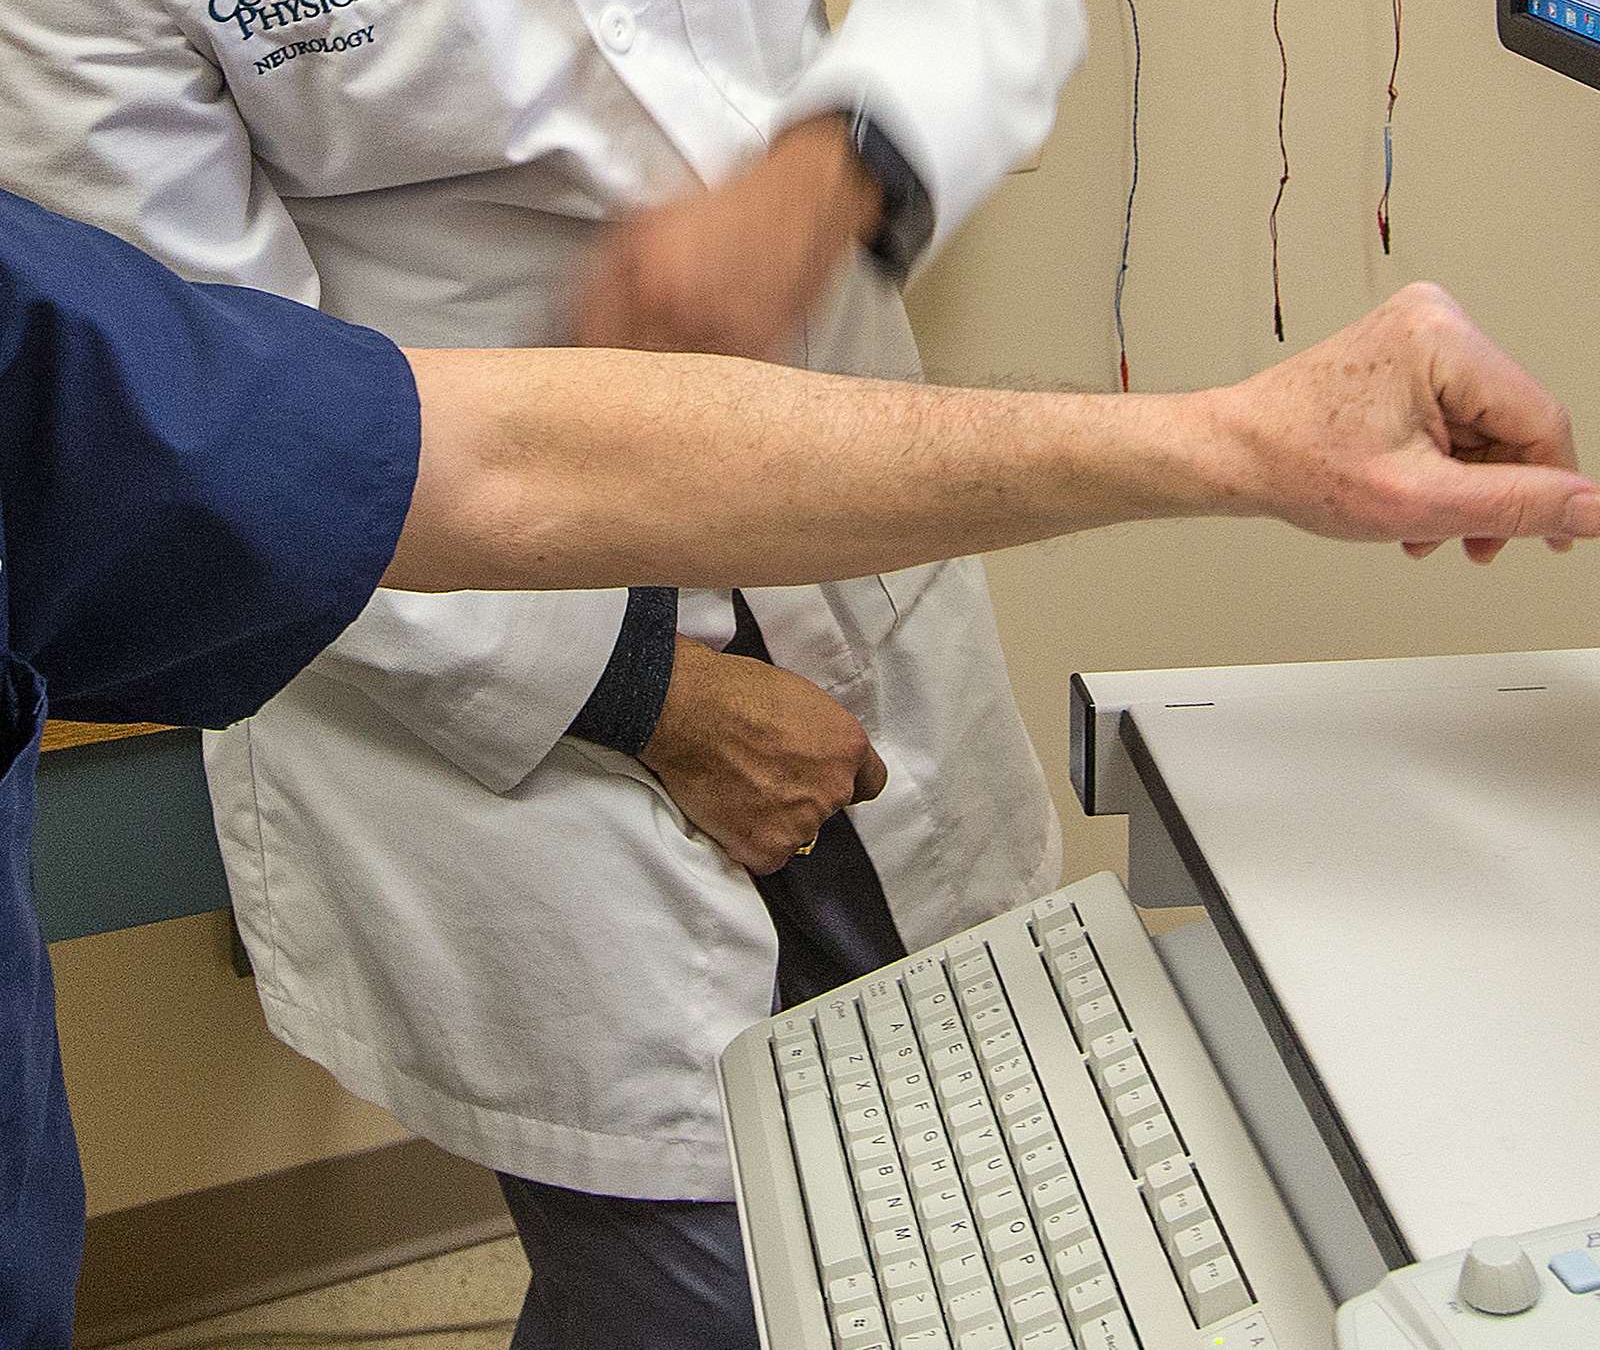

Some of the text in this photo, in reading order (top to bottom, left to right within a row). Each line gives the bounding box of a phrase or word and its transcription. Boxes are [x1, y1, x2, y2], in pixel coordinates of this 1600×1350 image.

[253, 25, 376, 76] NEUROLOGY
[932, 993, 947, 1004] Q
[890, 1022, 905, 1032] A
[941, 1018, 957, 1031] W
[899, 1047, 913, 1057] S
[949, 1042, 964, 1054] E
[849, 1054, 864, 1064] Z
[906, 1074, 920, 1085] D
[958, 1070, 973, 1082] R
[856, 1080, 871, 1091] X
[914, 1101, 930, 1112] F
[969, 1100, 983, 1109] T
[863, 1108, 879, 1119] C
[923, 1130, 938, 1142] G
[978, 1129, 993, 1140] Y
[872, 1135, 887, 1146] V
[931, 1159, 947, 1171] H
[987, 1157, 1003, 1170] U
[878, 1165, 894, 1176] B
[940, 1192, 956, 1201] J
[997, 1190, 1012, 1198] I
[887, 1196, 903, 1208] N
[950, 1221, 967, 1233] K
[1009, 1221, 1025, 1233] O
[895, 1227, 911, 1240] M
[960, 1254, 976, 1266] L
[1019, 1254, 1036, 1265] P
